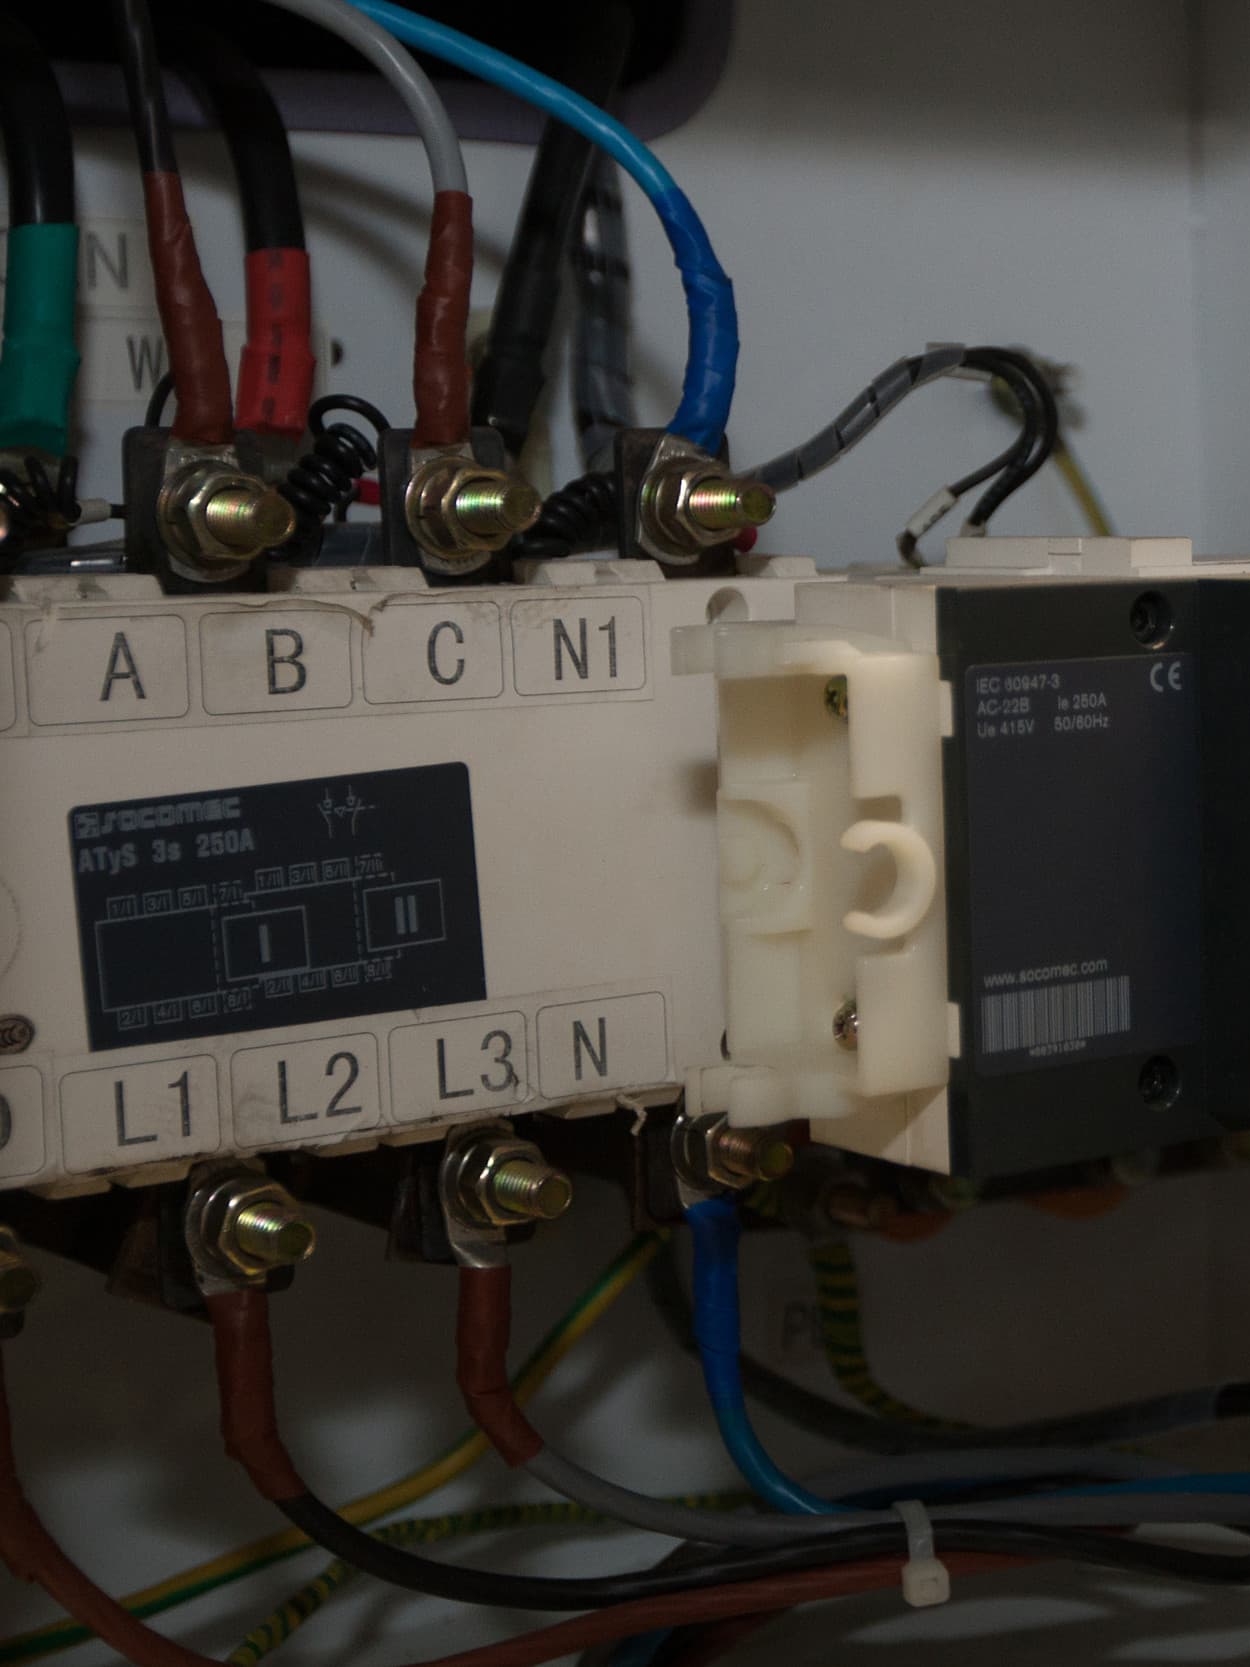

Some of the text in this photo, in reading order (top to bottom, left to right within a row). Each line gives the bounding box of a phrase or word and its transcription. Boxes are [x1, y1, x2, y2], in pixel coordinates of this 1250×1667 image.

[100, 615, 619, 702] A B C N1
[976, 677, 1000, 694] IEC
[999, 719, 1035, 736] 415V
[1053, 714, 1111, 733] 50/60Hz
[78, 827, 256, 875] ATyS 3s 250A
[114, 1016, 608, 1146] L1 L2 L3 N
